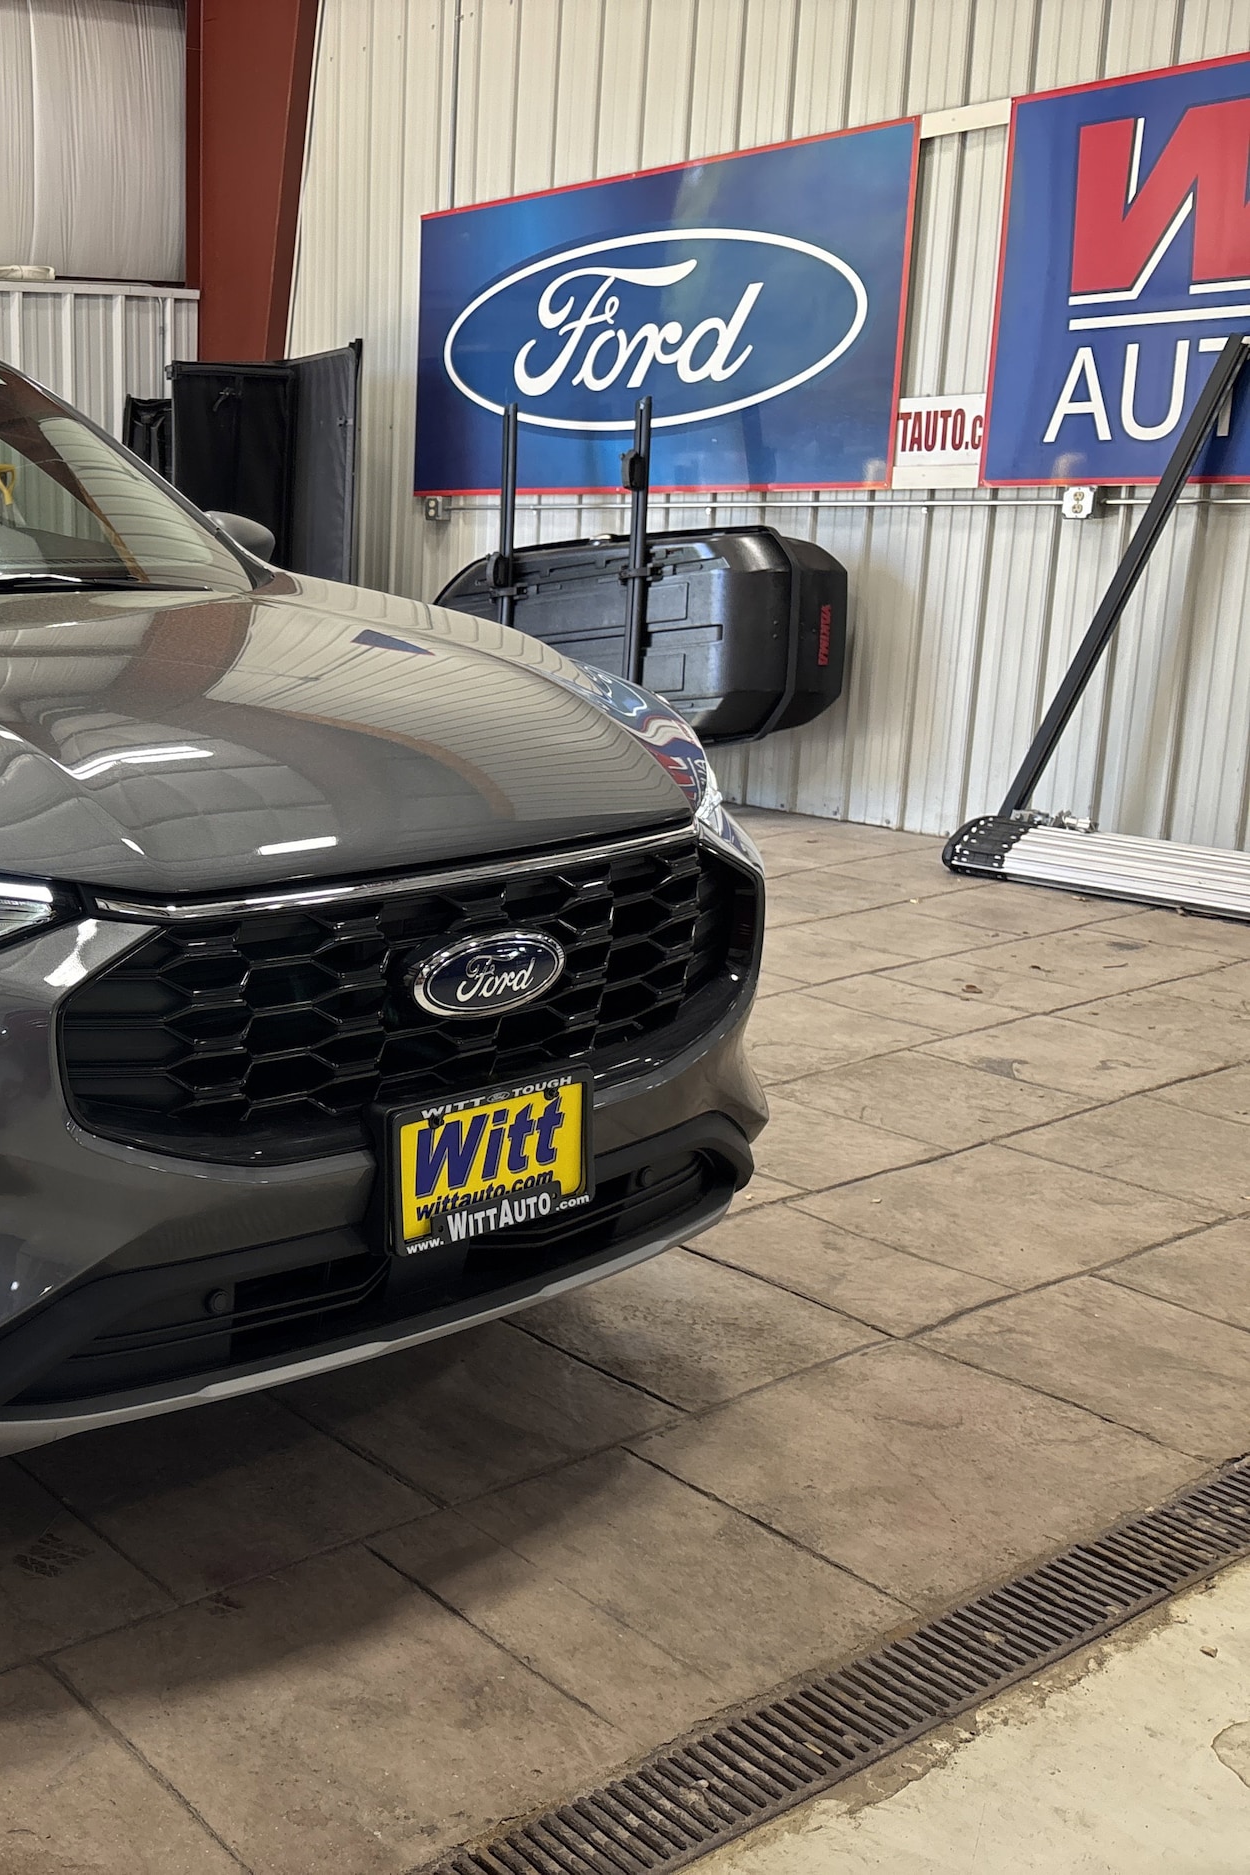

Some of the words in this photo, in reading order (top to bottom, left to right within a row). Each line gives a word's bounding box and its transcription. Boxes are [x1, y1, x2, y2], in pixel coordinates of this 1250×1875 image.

[514, 257, 765, 397] Ford
[897, 408, 984, 452] TAUTO.c
[455, 954, 536, 1002] Ford
[421, 1096, 486, 1119] WITT
[511, 1076, 572, 1097] TOUGH
[415, 1095, 565, 1199] Witt
[416, 1170, 554, 1221] wittauto.com
[406, 1237, 444, 1255] www.
[555, 1192, 590, 1212] .com
